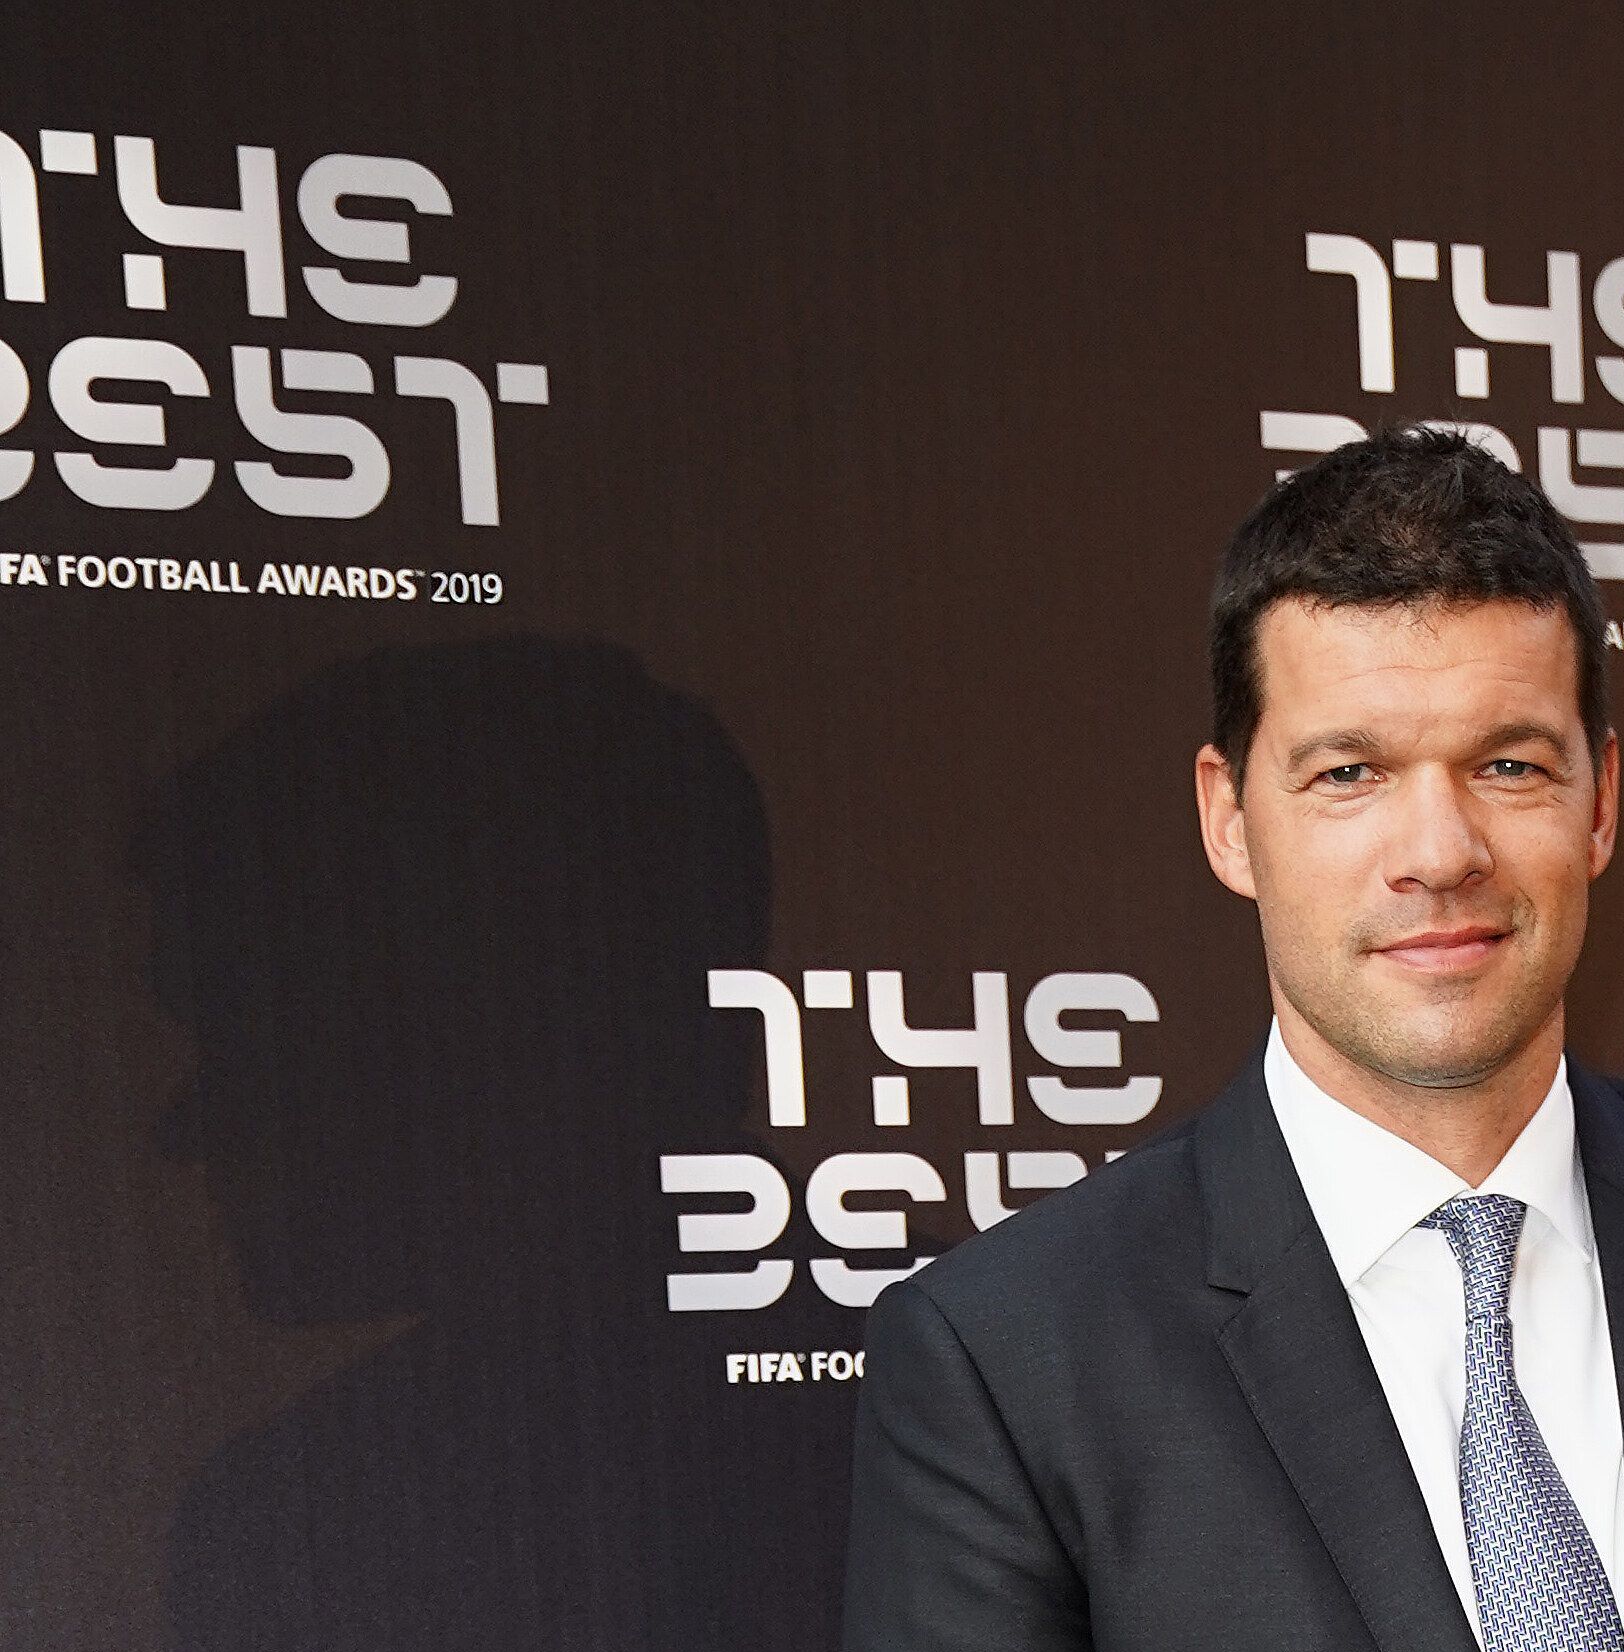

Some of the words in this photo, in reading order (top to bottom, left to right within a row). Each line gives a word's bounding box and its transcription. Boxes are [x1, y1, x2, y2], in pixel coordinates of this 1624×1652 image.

[0, 337, 548, 526] EST
[0, 553, 49, 586] FA
[58, 555, 250, 593] FOOTBALL
[257, 564, 416, 599] AWARDS
[431, 572, 502, 603] 2019
[708, 970, 1162, 1126] THE
[727, 1353, 804, 1383] FIFA
